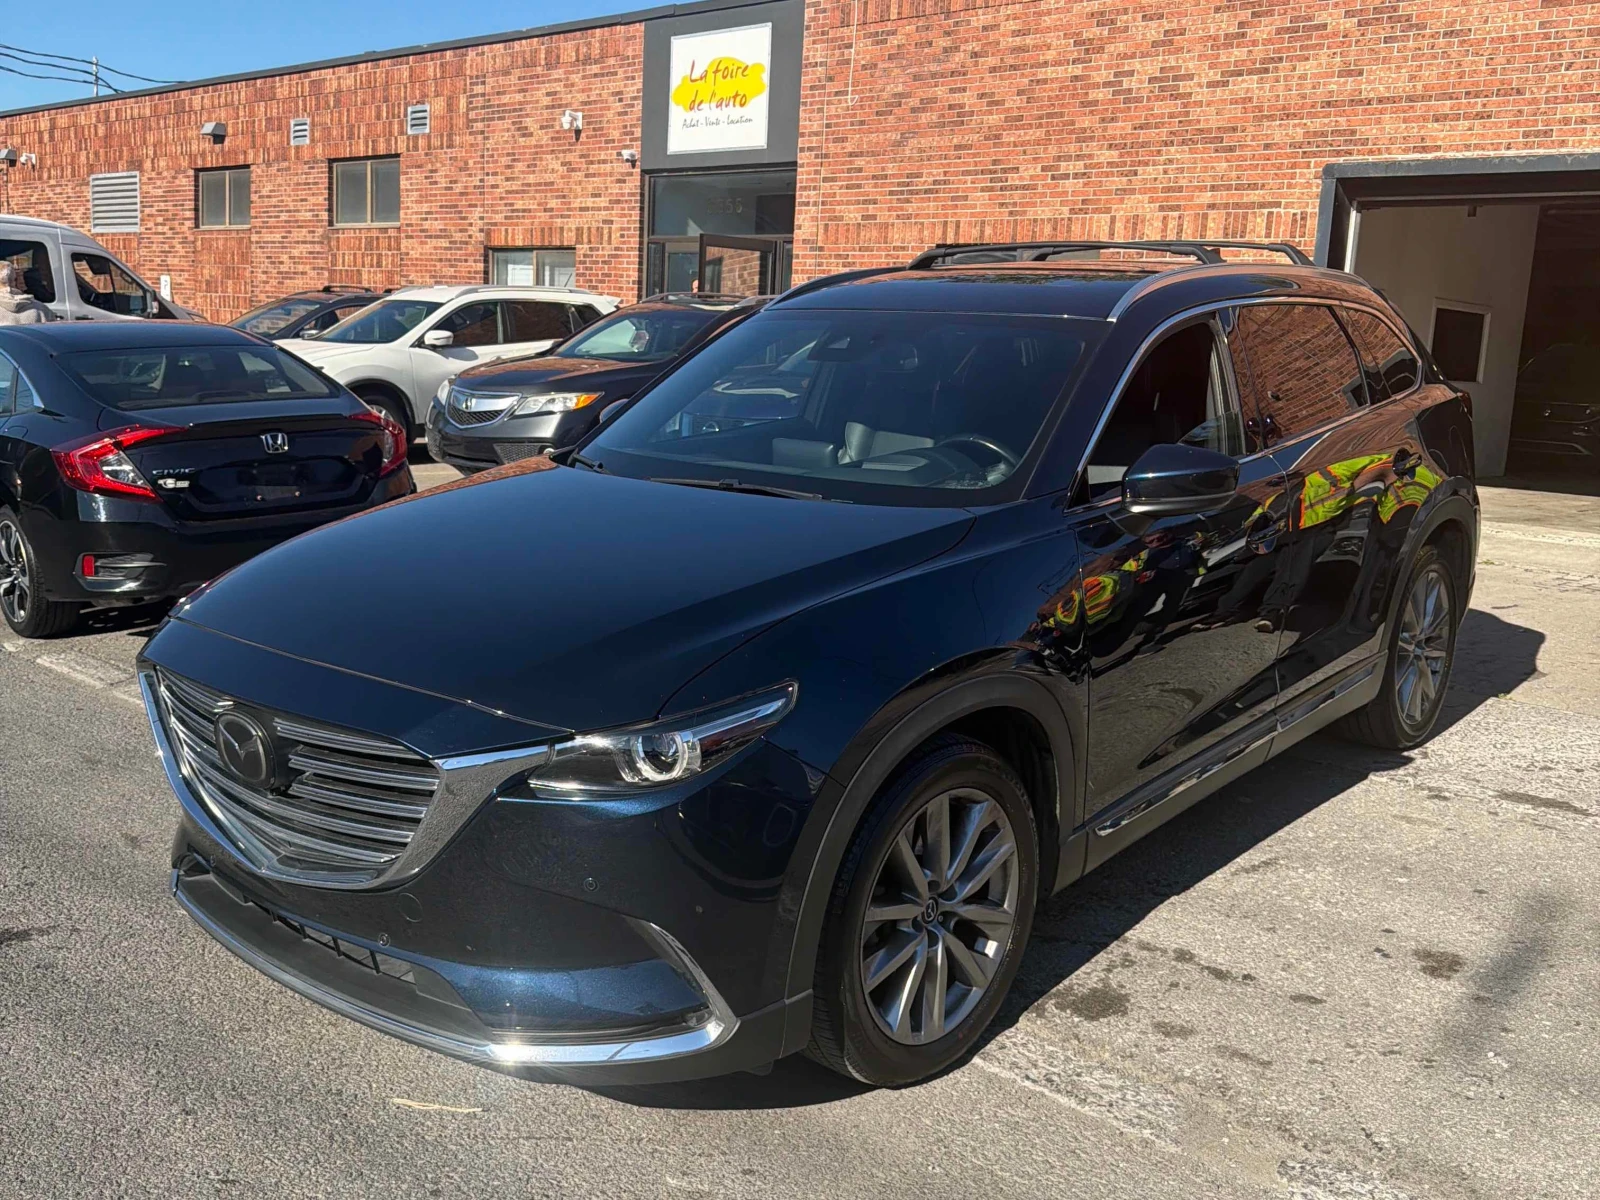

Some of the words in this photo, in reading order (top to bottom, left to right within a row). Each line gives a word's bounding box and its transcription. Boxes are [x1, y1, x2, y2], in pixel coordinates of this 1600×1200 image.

[690, 59, 708, 83] La
[712, 60, 749, 86] foire
[689, 89, 704, 112] de
[709, 89, 747, 111] l'auto
[682, 117, 699, 130] Achat
[705, 116, 720, 127] Vente
[727, 114, 753, 125] Location
[152, 467, 195, 475] CIVIC
